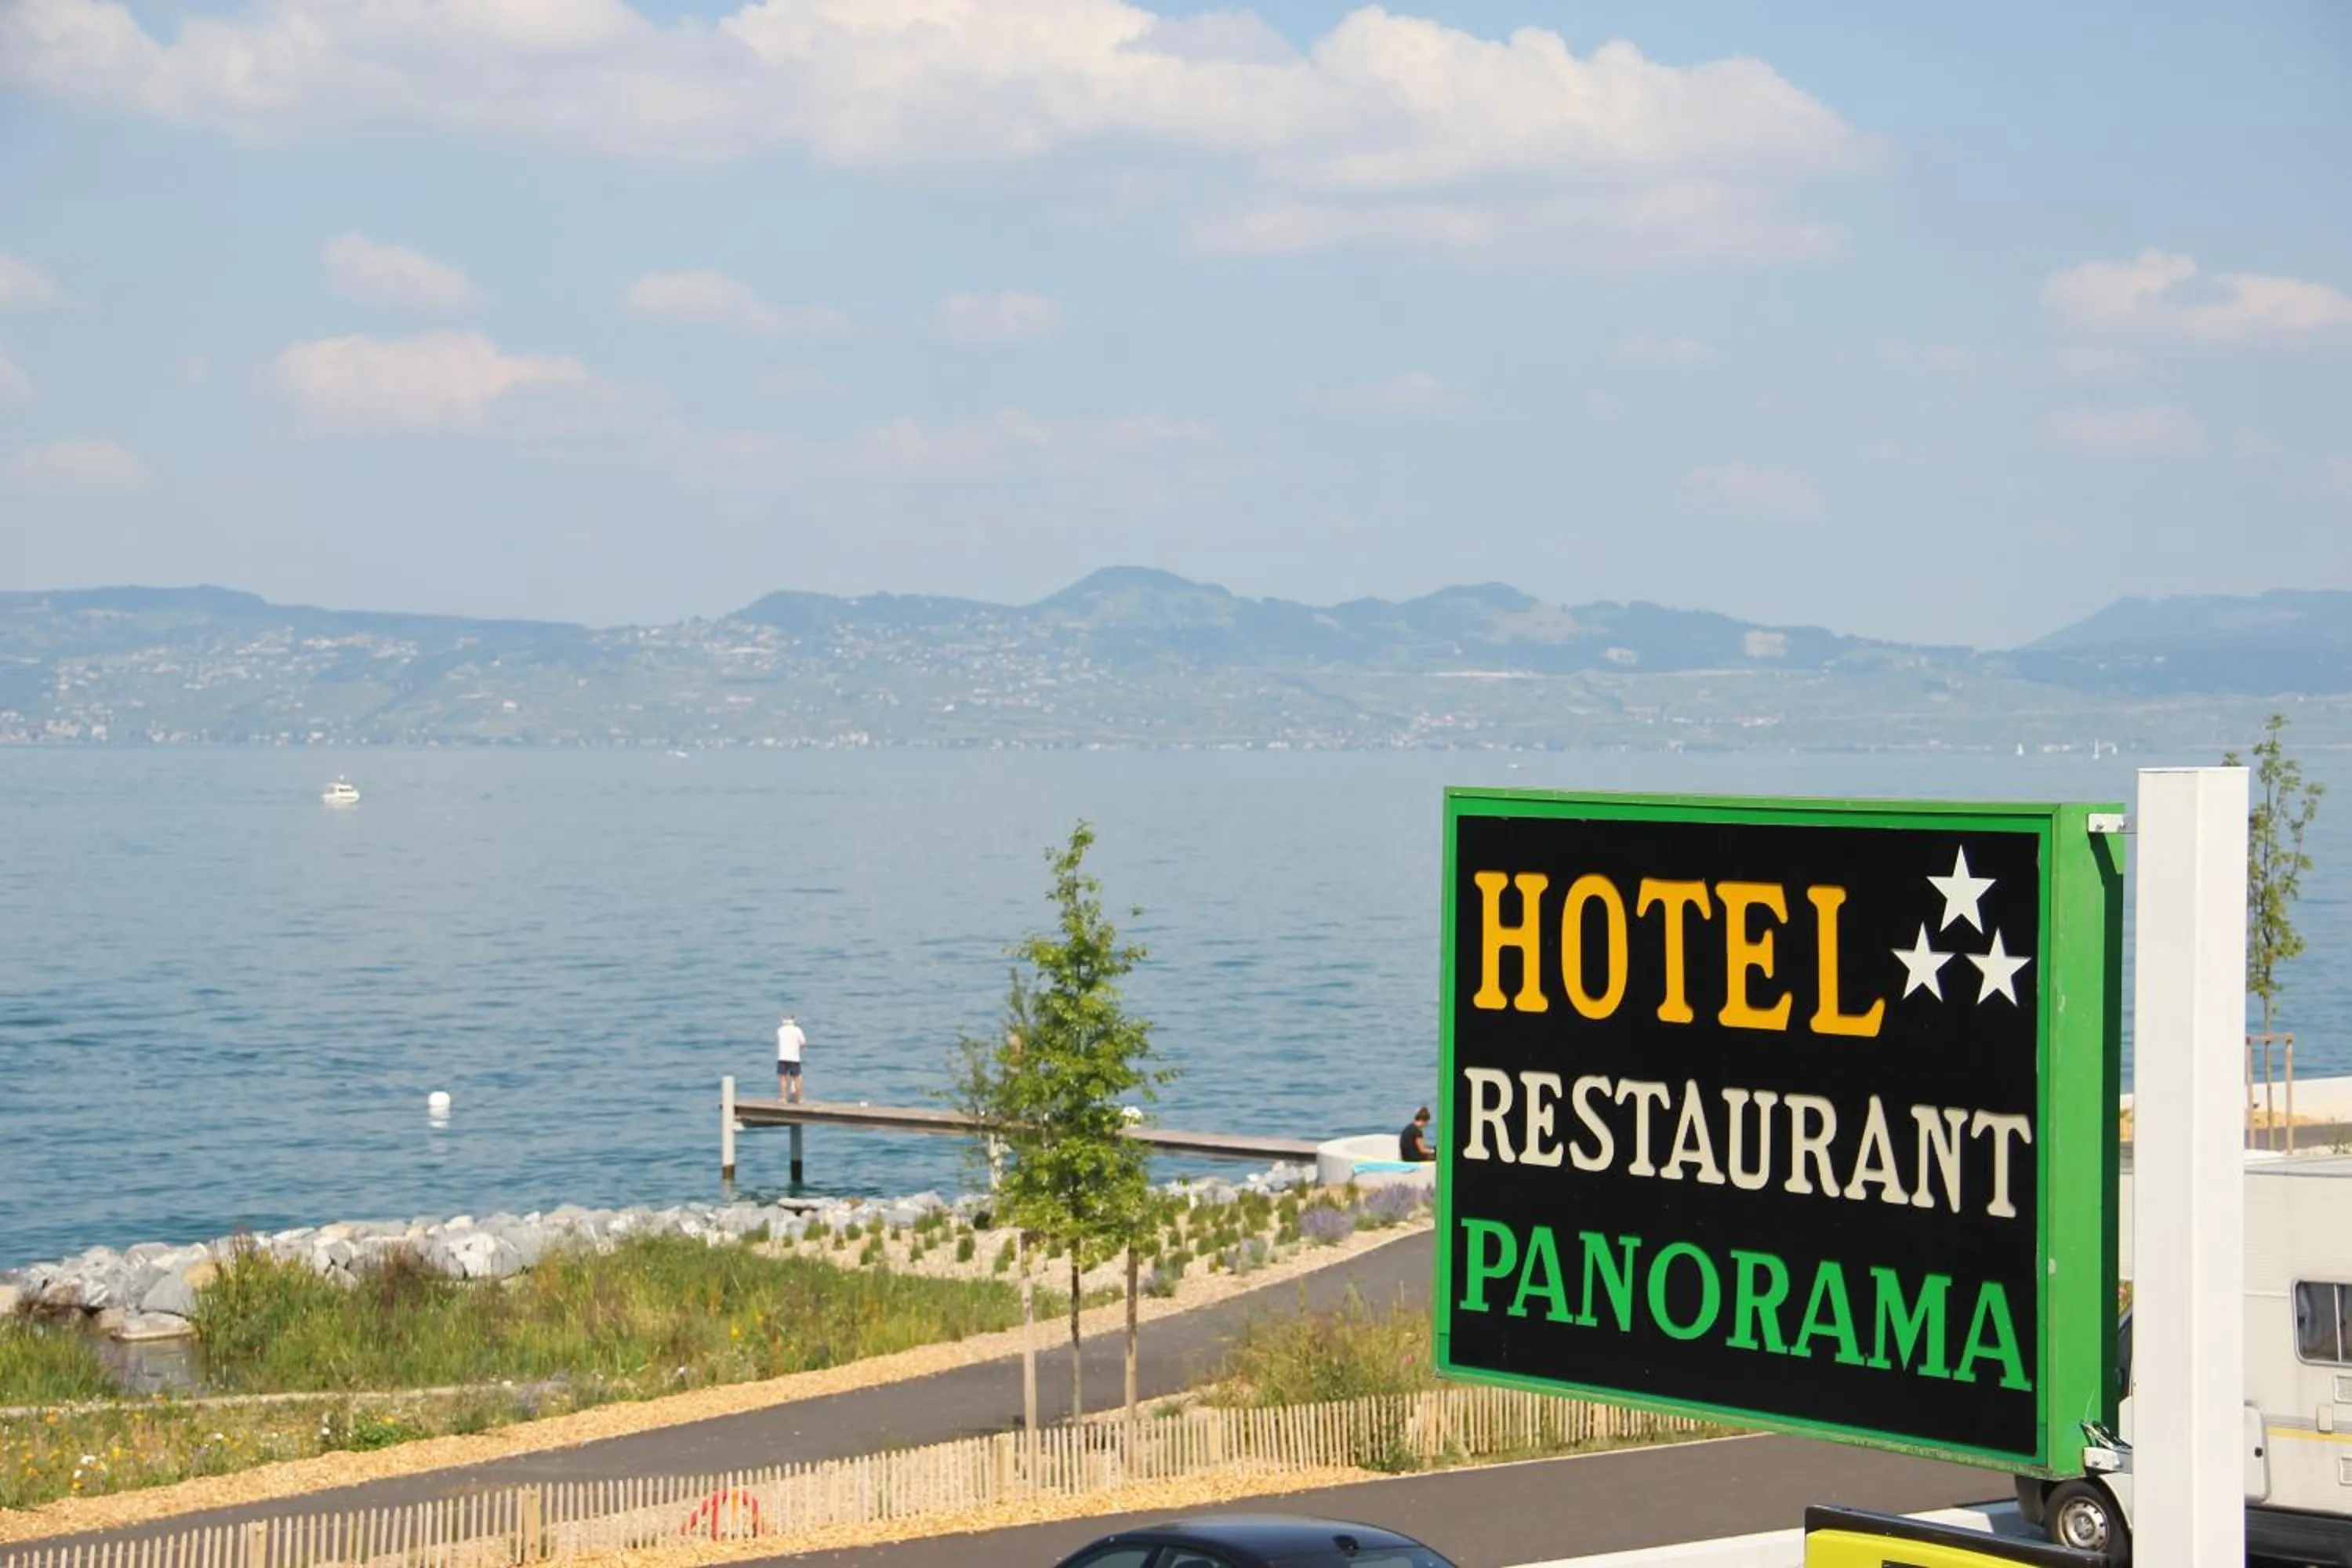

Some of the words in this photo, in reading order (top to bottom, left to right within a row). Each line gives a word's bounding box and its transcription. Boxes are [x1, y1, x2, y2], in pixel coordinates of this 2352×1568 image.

[1473, 871, 1885, 1036] HOTEL
[1463, 1067, 2031, 1218] RESTAURANT
[1460, 1218, 2032, 1391] PANORAMA
